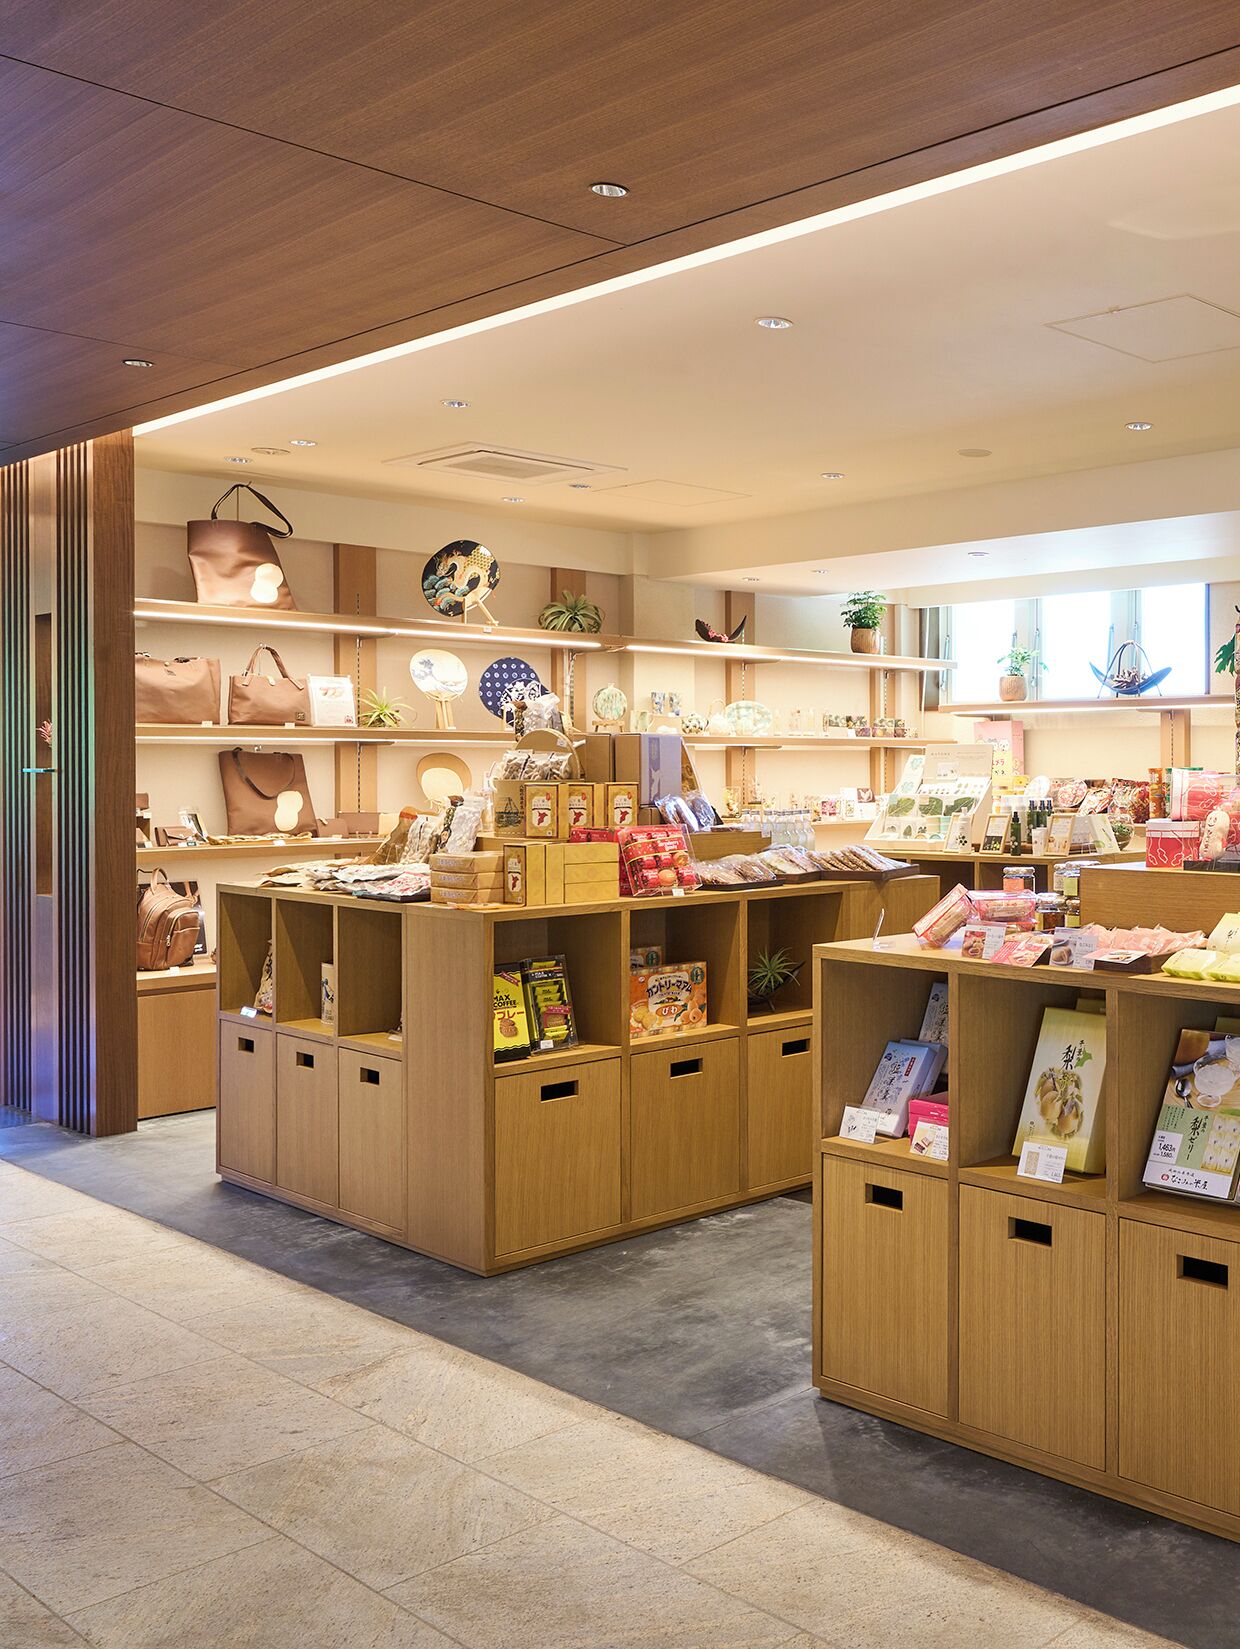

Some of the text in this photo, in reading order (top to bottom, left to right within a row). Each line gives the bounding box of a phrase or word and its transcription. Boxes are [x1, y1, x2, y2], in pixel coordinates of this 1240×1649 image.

[646, 980, 692, 998] カントリーマアム
[662, 1006, 678, 1015] びわ
[1062, 1044, 1077, 1070] 梨
[1186, 1116, 1202, 1160] 梨ゼリー
